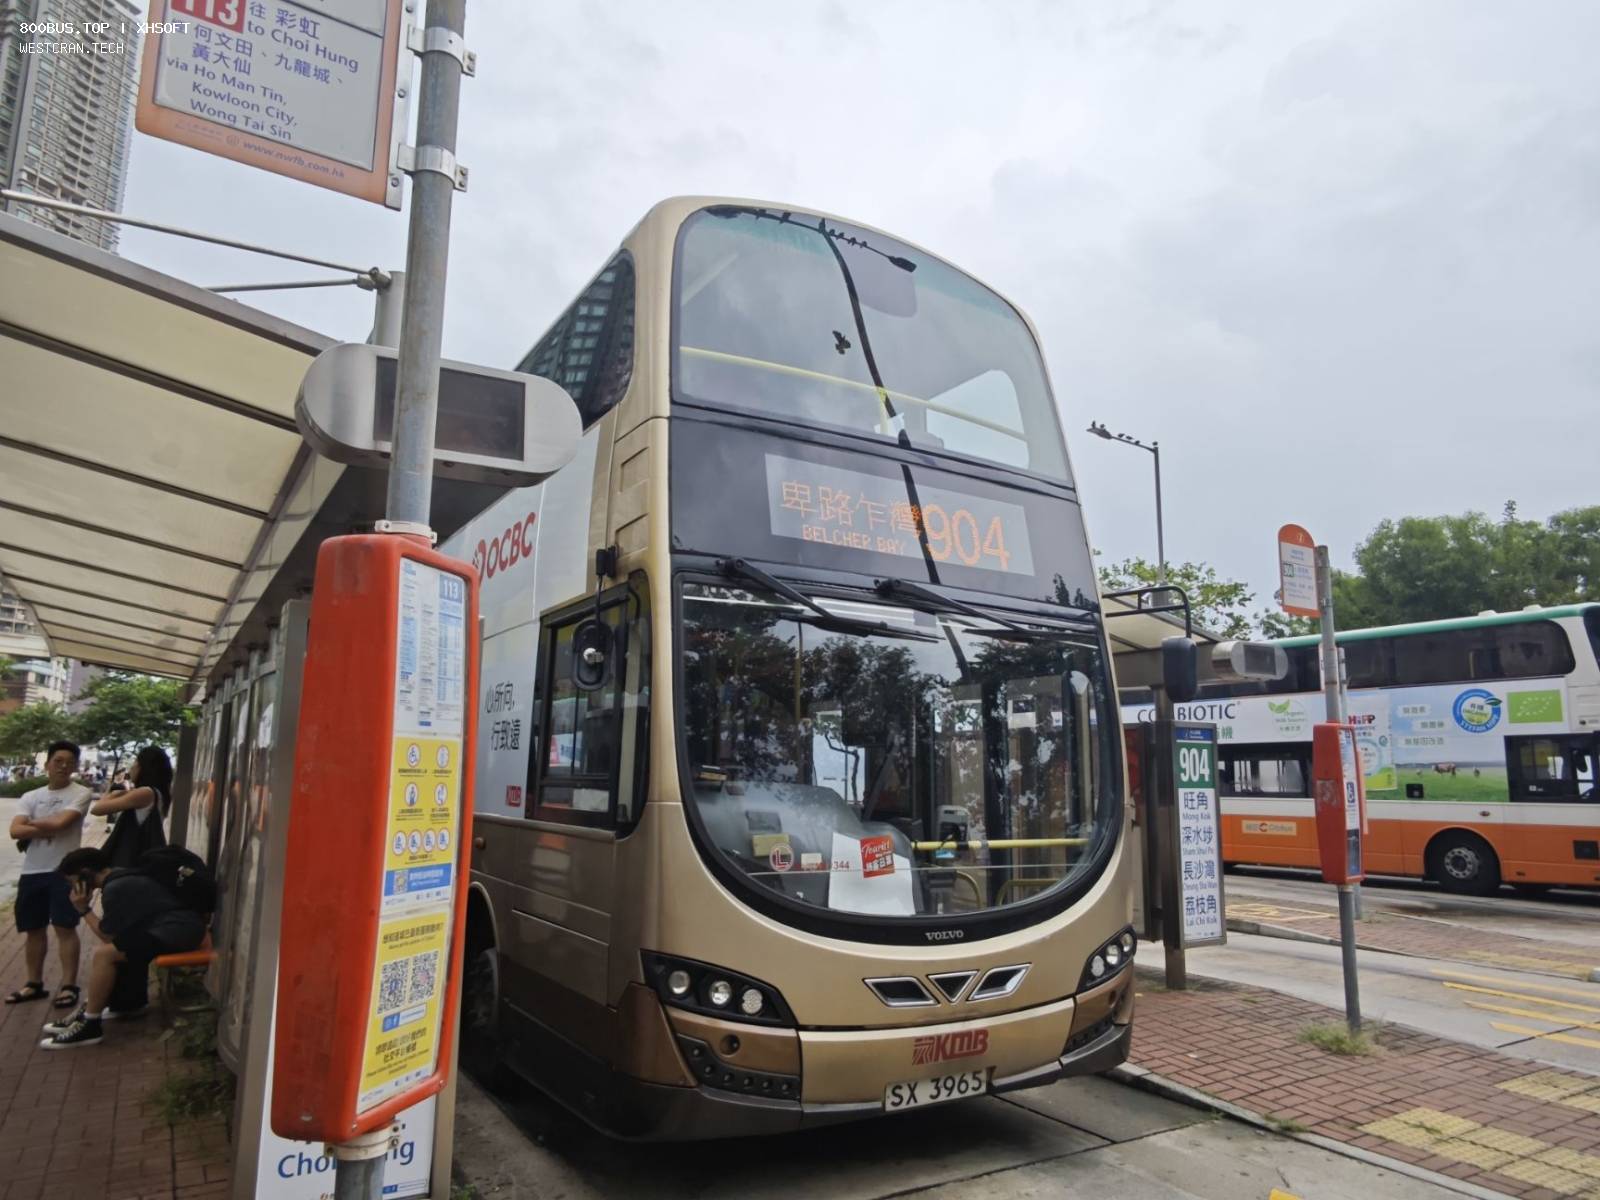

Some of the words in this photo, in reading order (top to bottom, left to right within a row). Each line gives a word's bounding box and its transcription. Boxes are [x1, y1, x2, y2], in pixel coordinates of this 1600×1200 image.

[249, 2, 267, 20] 往
[275, 8, 321, 40] 彩虹
[192, 43, 252, 76] 黃大仙
[248, 21, 265, 36] to
[271, 29, 309, 52] Choi
[315, 44, 359, 73] Hung
[166, 57, 188, 71] via
[194, 64, 216, 81] Ho
[221, 74, 255, 95] Man
[261, 86, 287, 106] Tin,
[190, 99, 237, 127] Wong
[243, 115, 264, 131] Tai
[270, 121, 292, 141] Sin
[192, 81, 260, 113] Kowloon
[264, 106, 298, 127] City,
[487, 512, 536, 579] OCBC
[922, 503, 1011, 572] 904
[442, 579, 459, 600] 113
[1179, 747, 1210, 782] 904
[1184, 792, 1208, 810] 旺角
[1184, 860, 1215, 880] 長沙灣
[1184, 895, 1217, 916] 荔枝角
[925, 929, 965, 941] VOLVO
[933, 1028, 989, 1065] KMB
[890, 1081, 918, 1108] SX
[929, 1071, 983, 1101] 3965
